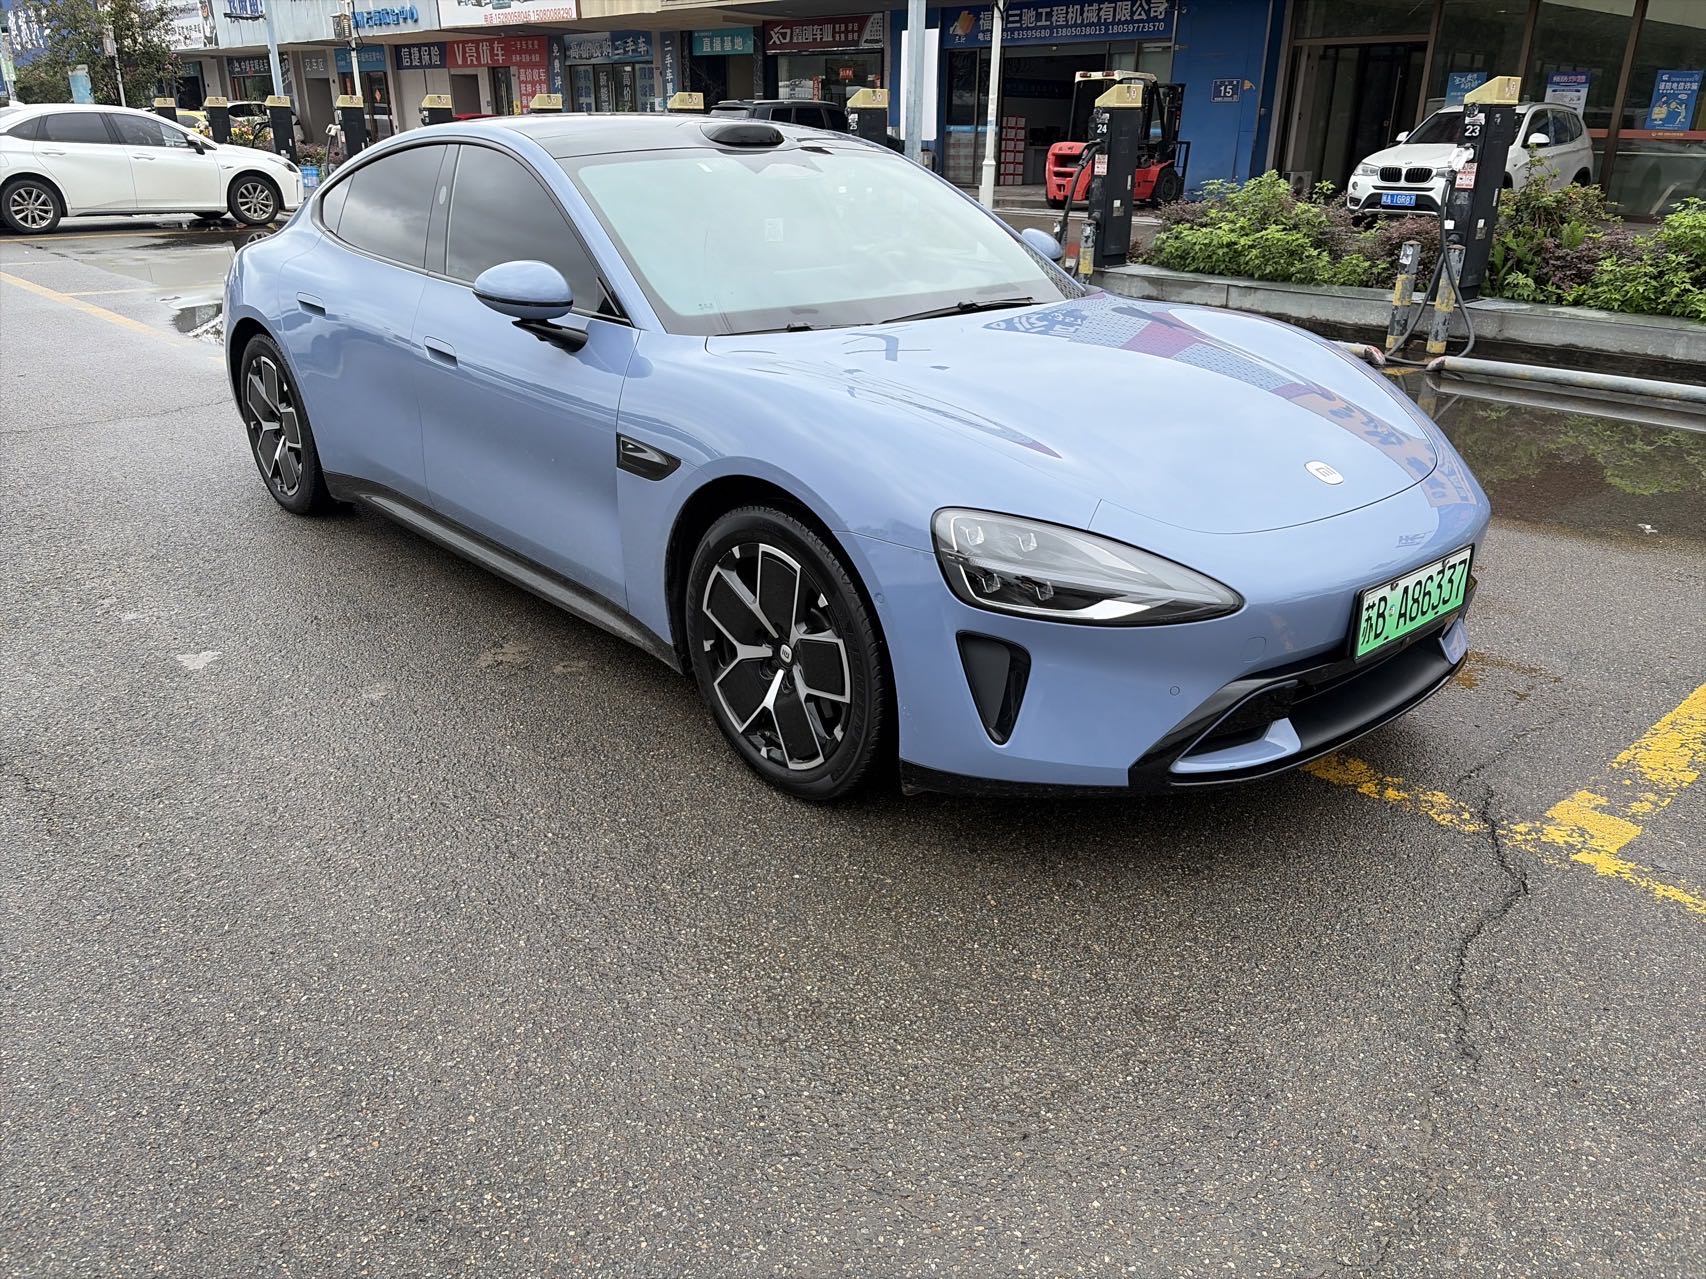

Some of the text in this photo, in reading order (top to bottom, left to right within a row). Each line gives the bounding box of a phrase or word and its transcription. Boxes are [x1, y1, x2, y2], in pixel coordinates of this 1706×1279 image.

[979, 0, 1167, 31] 福三驰工程机械有限公司
[1053, 26, 1105, 37] 13805038013
[1108, 22, 1165, 34] 18059773570
[702, 36, 744, 52] 直播基地
[401, 45, 441, 67] 信捷保险
[519, 69, 546, 82] 高价收车
[1219, 85, 1233, 97] 15
[1096, 124, 1108, 134] 24
[1464, 125, 1481, 137] 23
